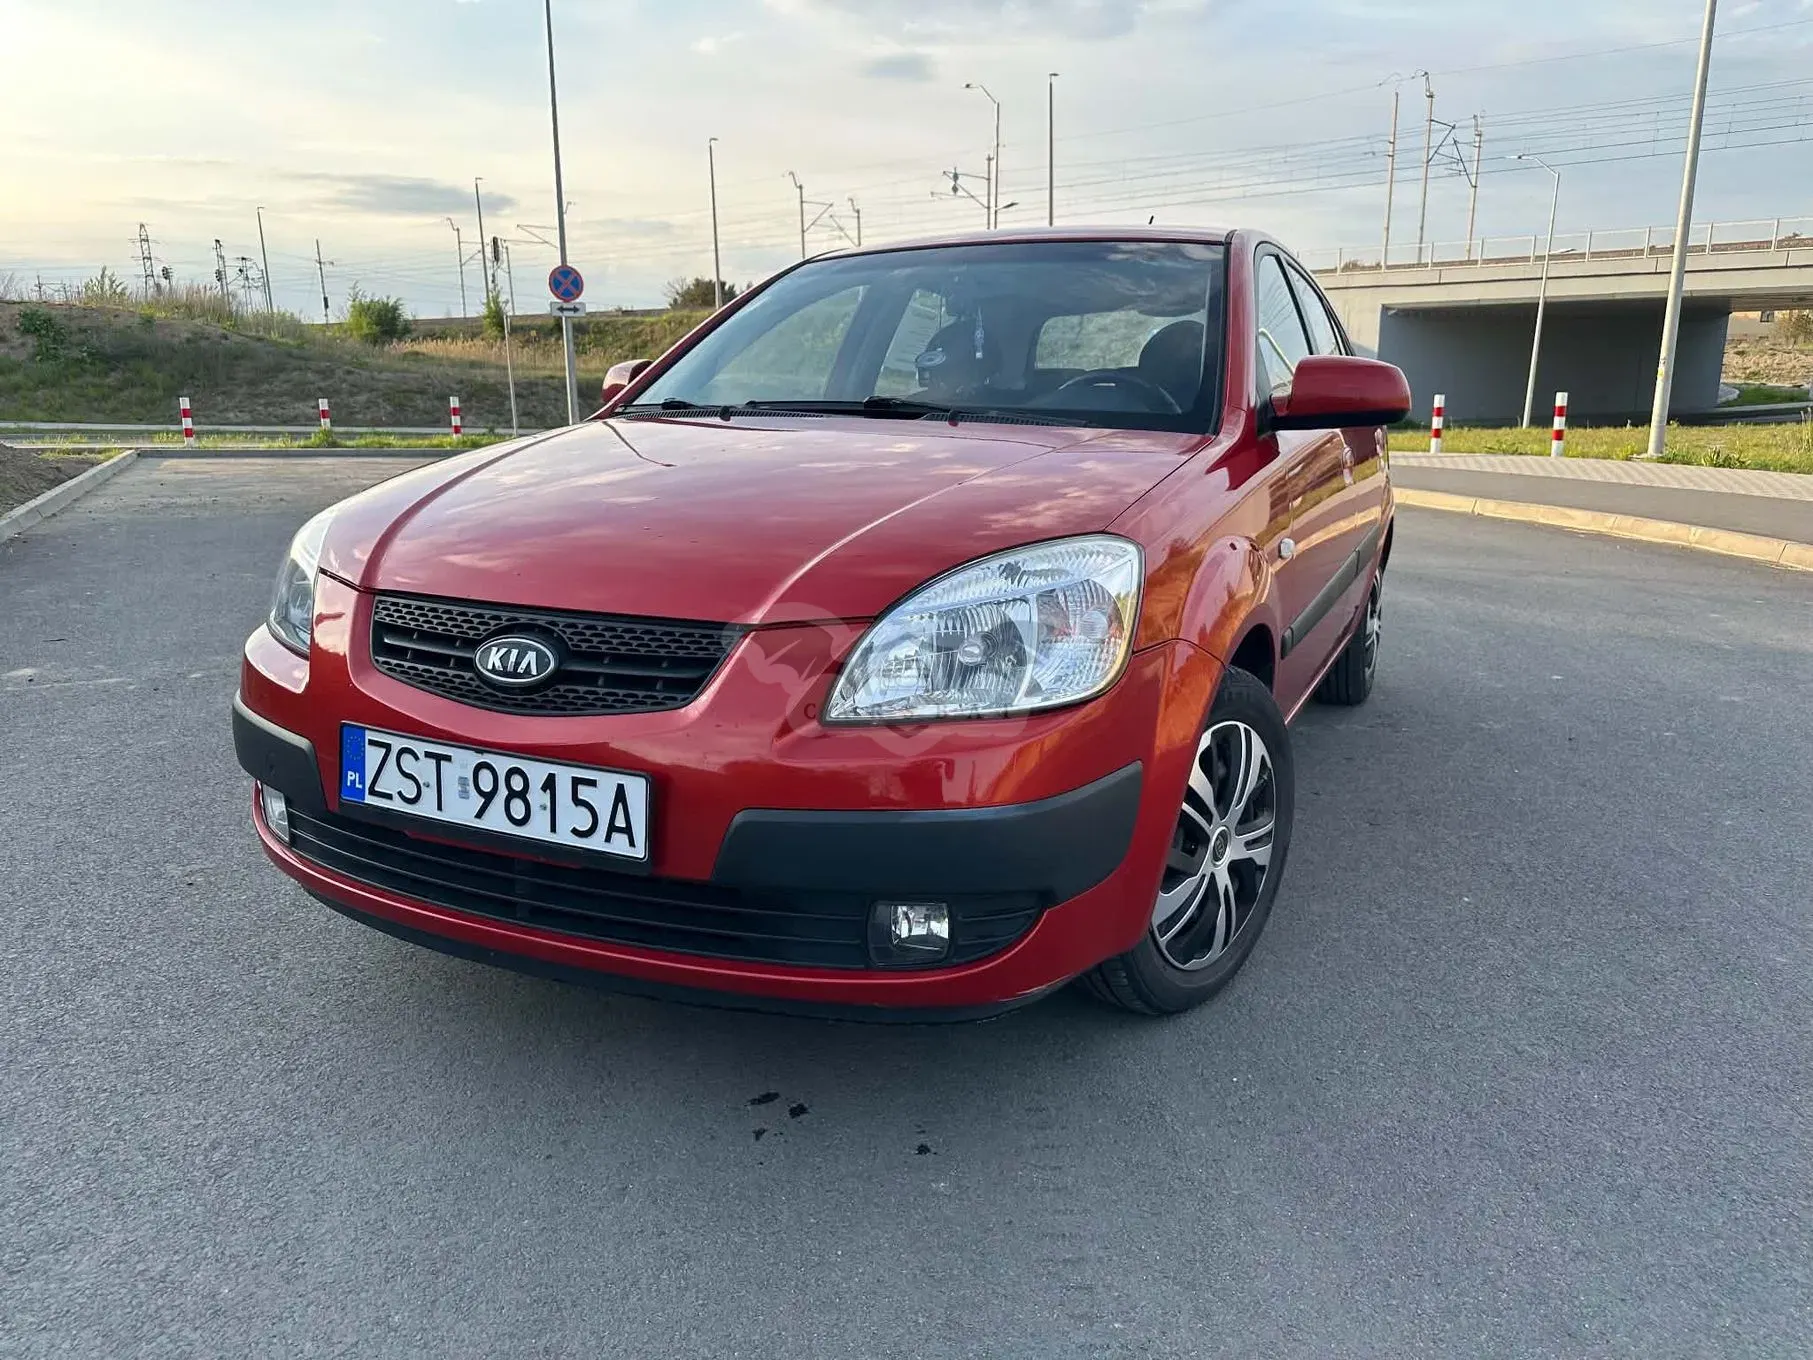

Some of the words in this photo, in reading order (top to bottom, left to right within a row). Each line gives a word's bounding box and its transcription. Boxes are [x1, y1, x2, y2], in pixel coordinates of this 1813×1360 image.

[487, 646, 538, 676] KIA
[346, 770, 363, 789] PL
[367, 738, 452, 811] ZST
[472, 760, 636, 848] 9815A
